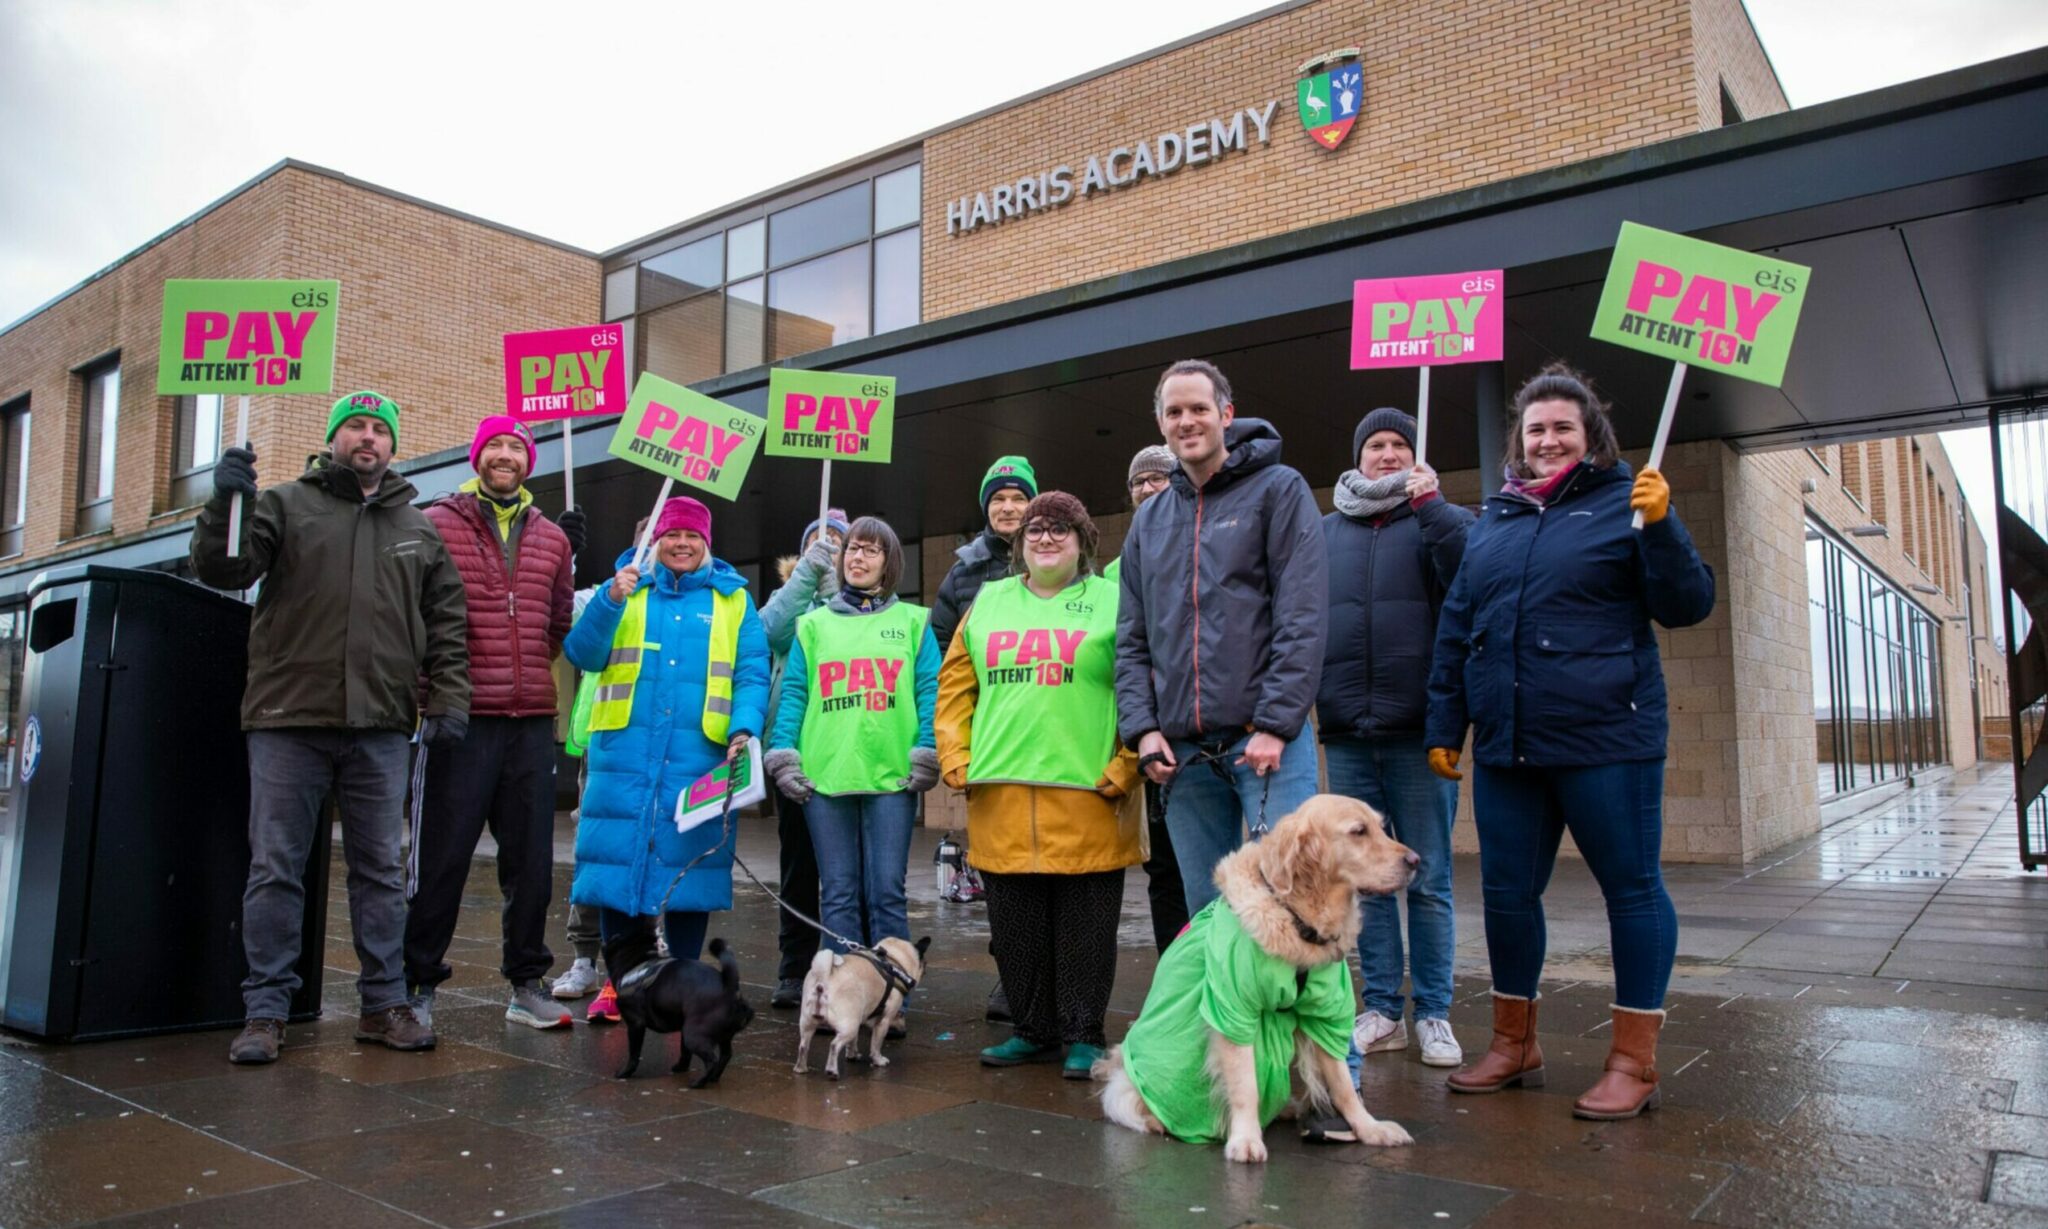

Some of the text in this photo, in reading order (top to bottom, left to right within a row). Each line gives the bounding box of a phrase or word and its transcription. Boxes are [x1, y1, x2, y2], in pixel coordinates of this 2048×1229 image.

[946, 100, 1281, 237] HARRIS ACADEMY
[291, 288, 329, 308] eis
[1461, 276, 1496, 293] eis
[1625, 259, 1782, 343] PAY
[1754, 269, 1798, 294] eis
[183, 311, 319, 360] PAY
[1371, 295, 1487, 341] PAY
[591, 329, 618, 347] eis
[520, 349, 612, 396] PAY
[861, 381, 889, 398] eis
[728, 416, 757, 437] eis
[783, 393, 882, 435] PAY
[635, 400, 746, 468] PAY
[1065, 600, 1094, 613] eis
[880, 626, 906, 640] eis
[986, 629, 1088, 668] PAY
[819, 658, 904, 698] PAY
